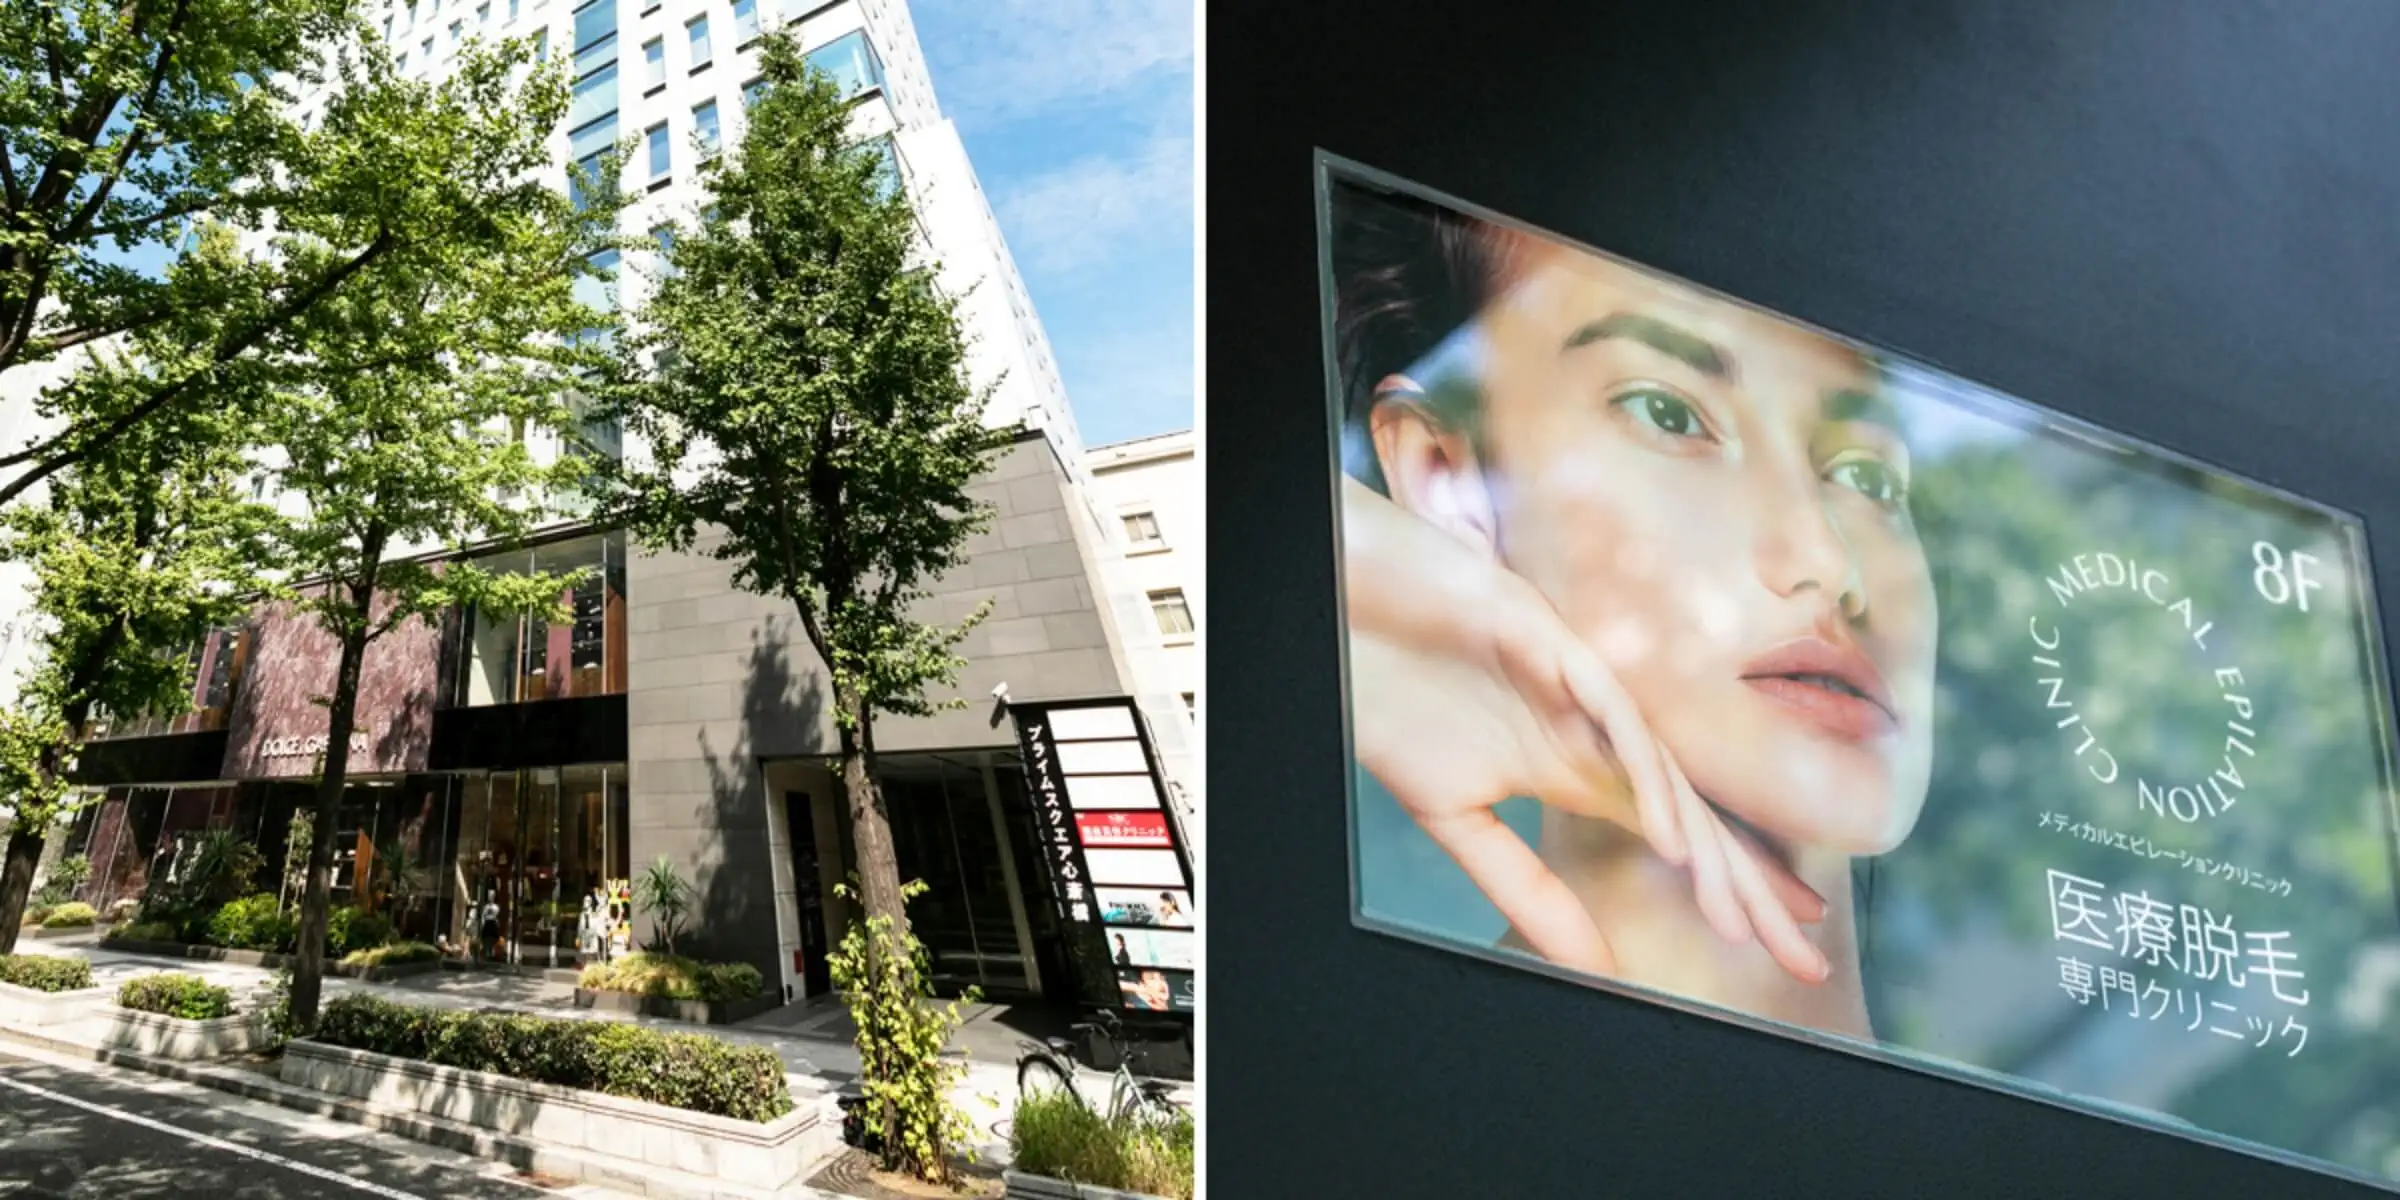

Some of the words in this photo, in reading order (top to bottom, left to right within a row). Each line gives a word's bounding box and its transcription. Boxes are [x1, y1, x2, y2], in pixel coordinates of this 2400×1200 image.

[2045, 552, 2214, 652] MEDICAL
[2252, 540, 2324, 613] 8F
[2029, 615, 2119, 784] CLINIC
[2136, 666, 2256, 823] EPILATION
[2046, 867, 2311, 1007] 医療脱毛
[2055, 955, 2310, 1058] 専門クリニック
